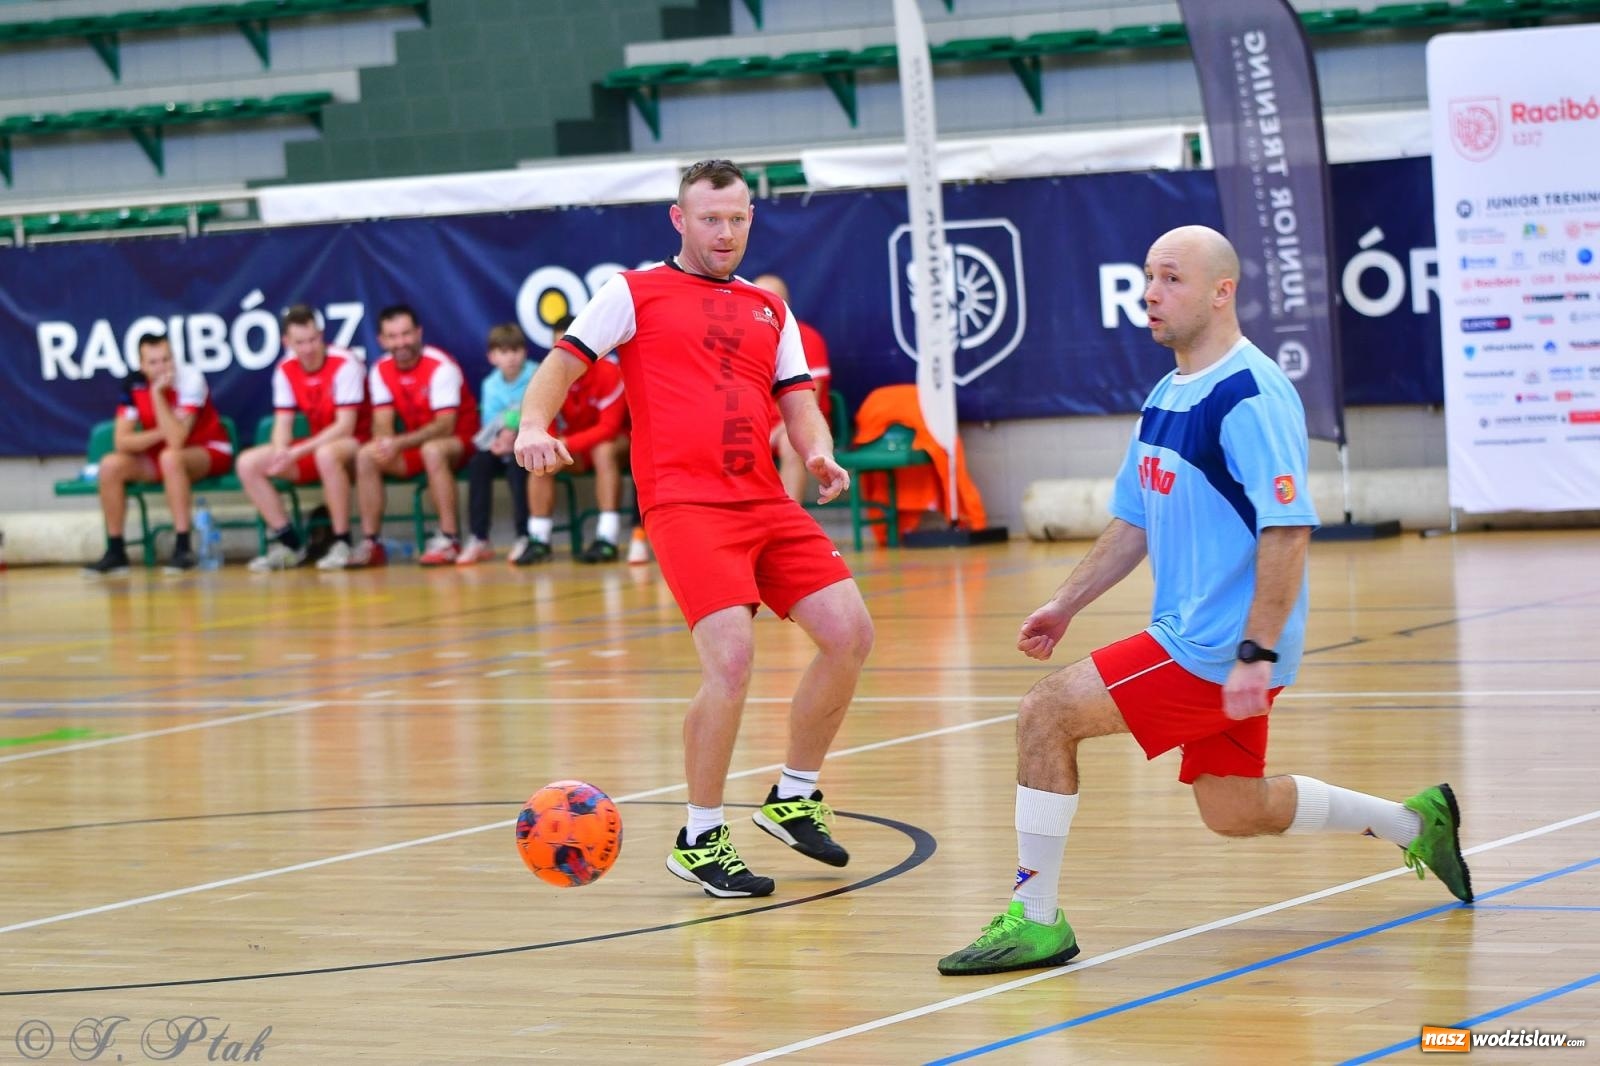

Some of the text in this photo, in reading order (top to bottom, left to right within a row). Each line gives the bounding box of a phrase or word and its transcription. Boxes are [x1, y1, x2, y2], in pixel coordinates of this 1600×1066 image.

[1486, 191, 1600, 209] JUNIOR TRENIN
[36, 288, 366, 381] RACIBÓZ
